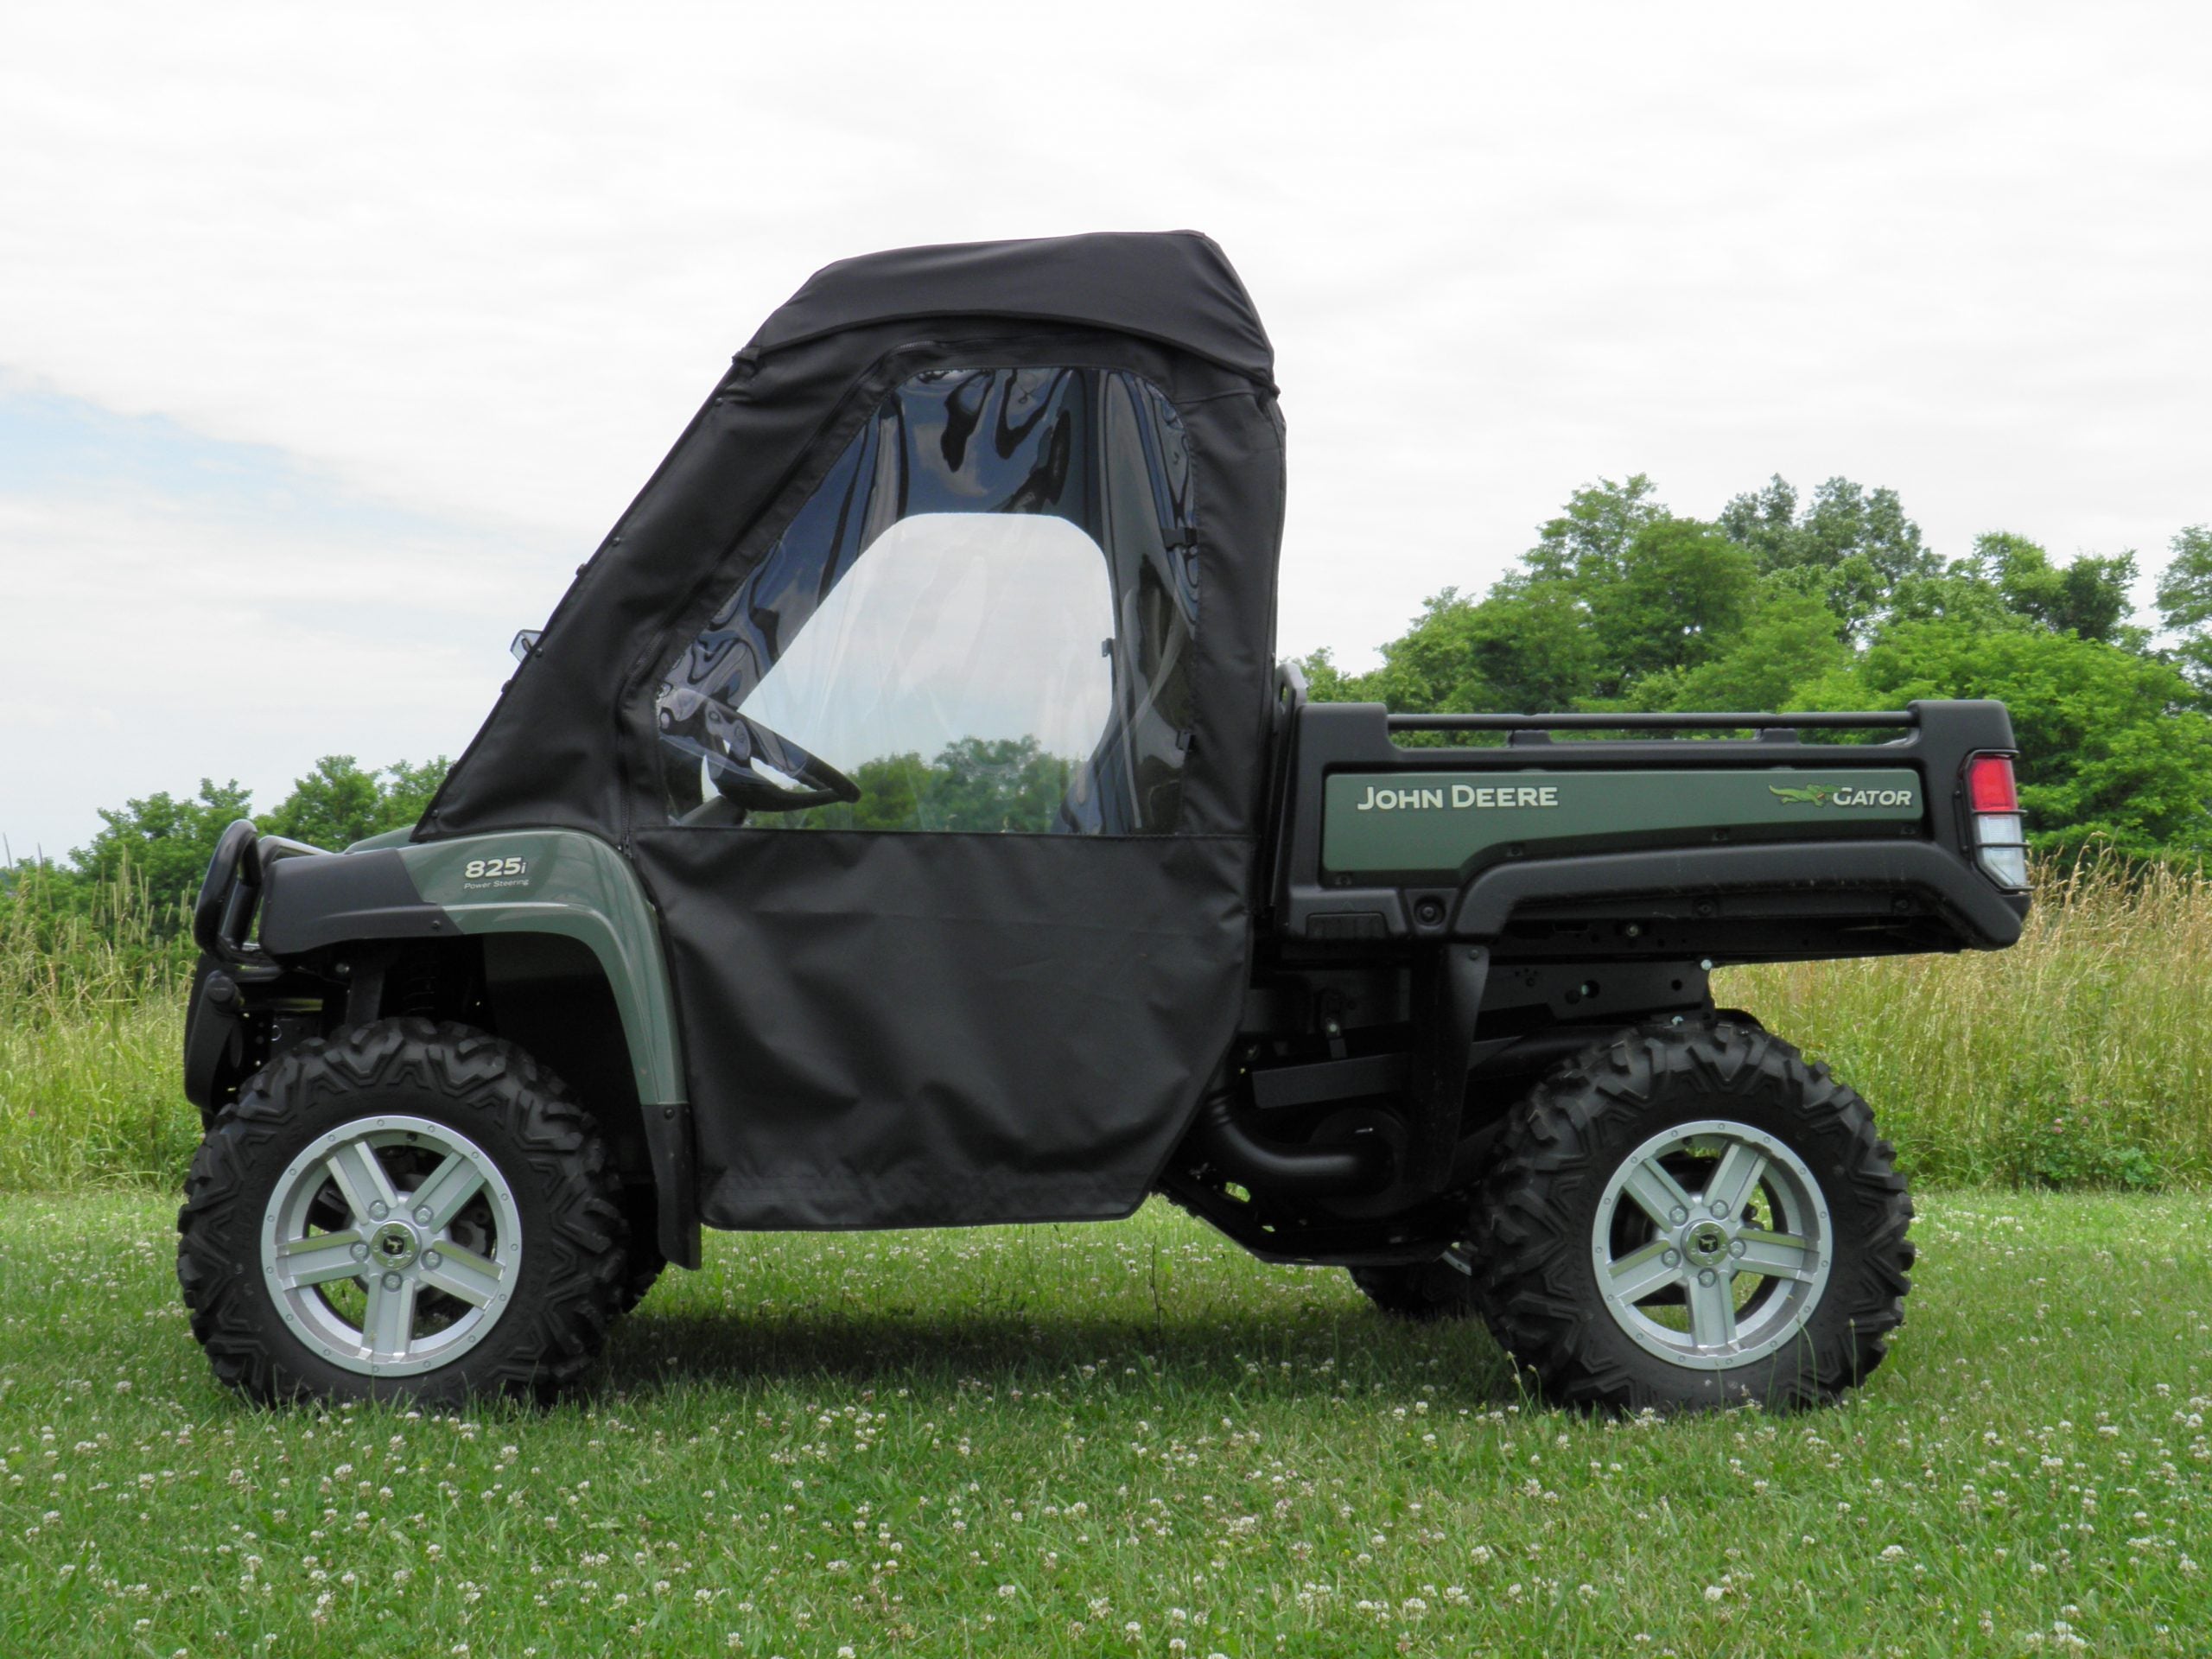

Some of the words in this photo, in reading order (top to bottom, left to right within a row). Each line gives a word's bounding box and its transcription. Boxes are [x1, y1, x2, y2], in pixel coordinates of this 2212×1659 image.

[1357, 785, 1444, 810] JOHN
[1452, 785, 1559, 808] DEERE
[1832, 786, 1913, 807] GATOR
[464, 856, 527, 878] 825i
[493, 879, 530, 887] Steering
